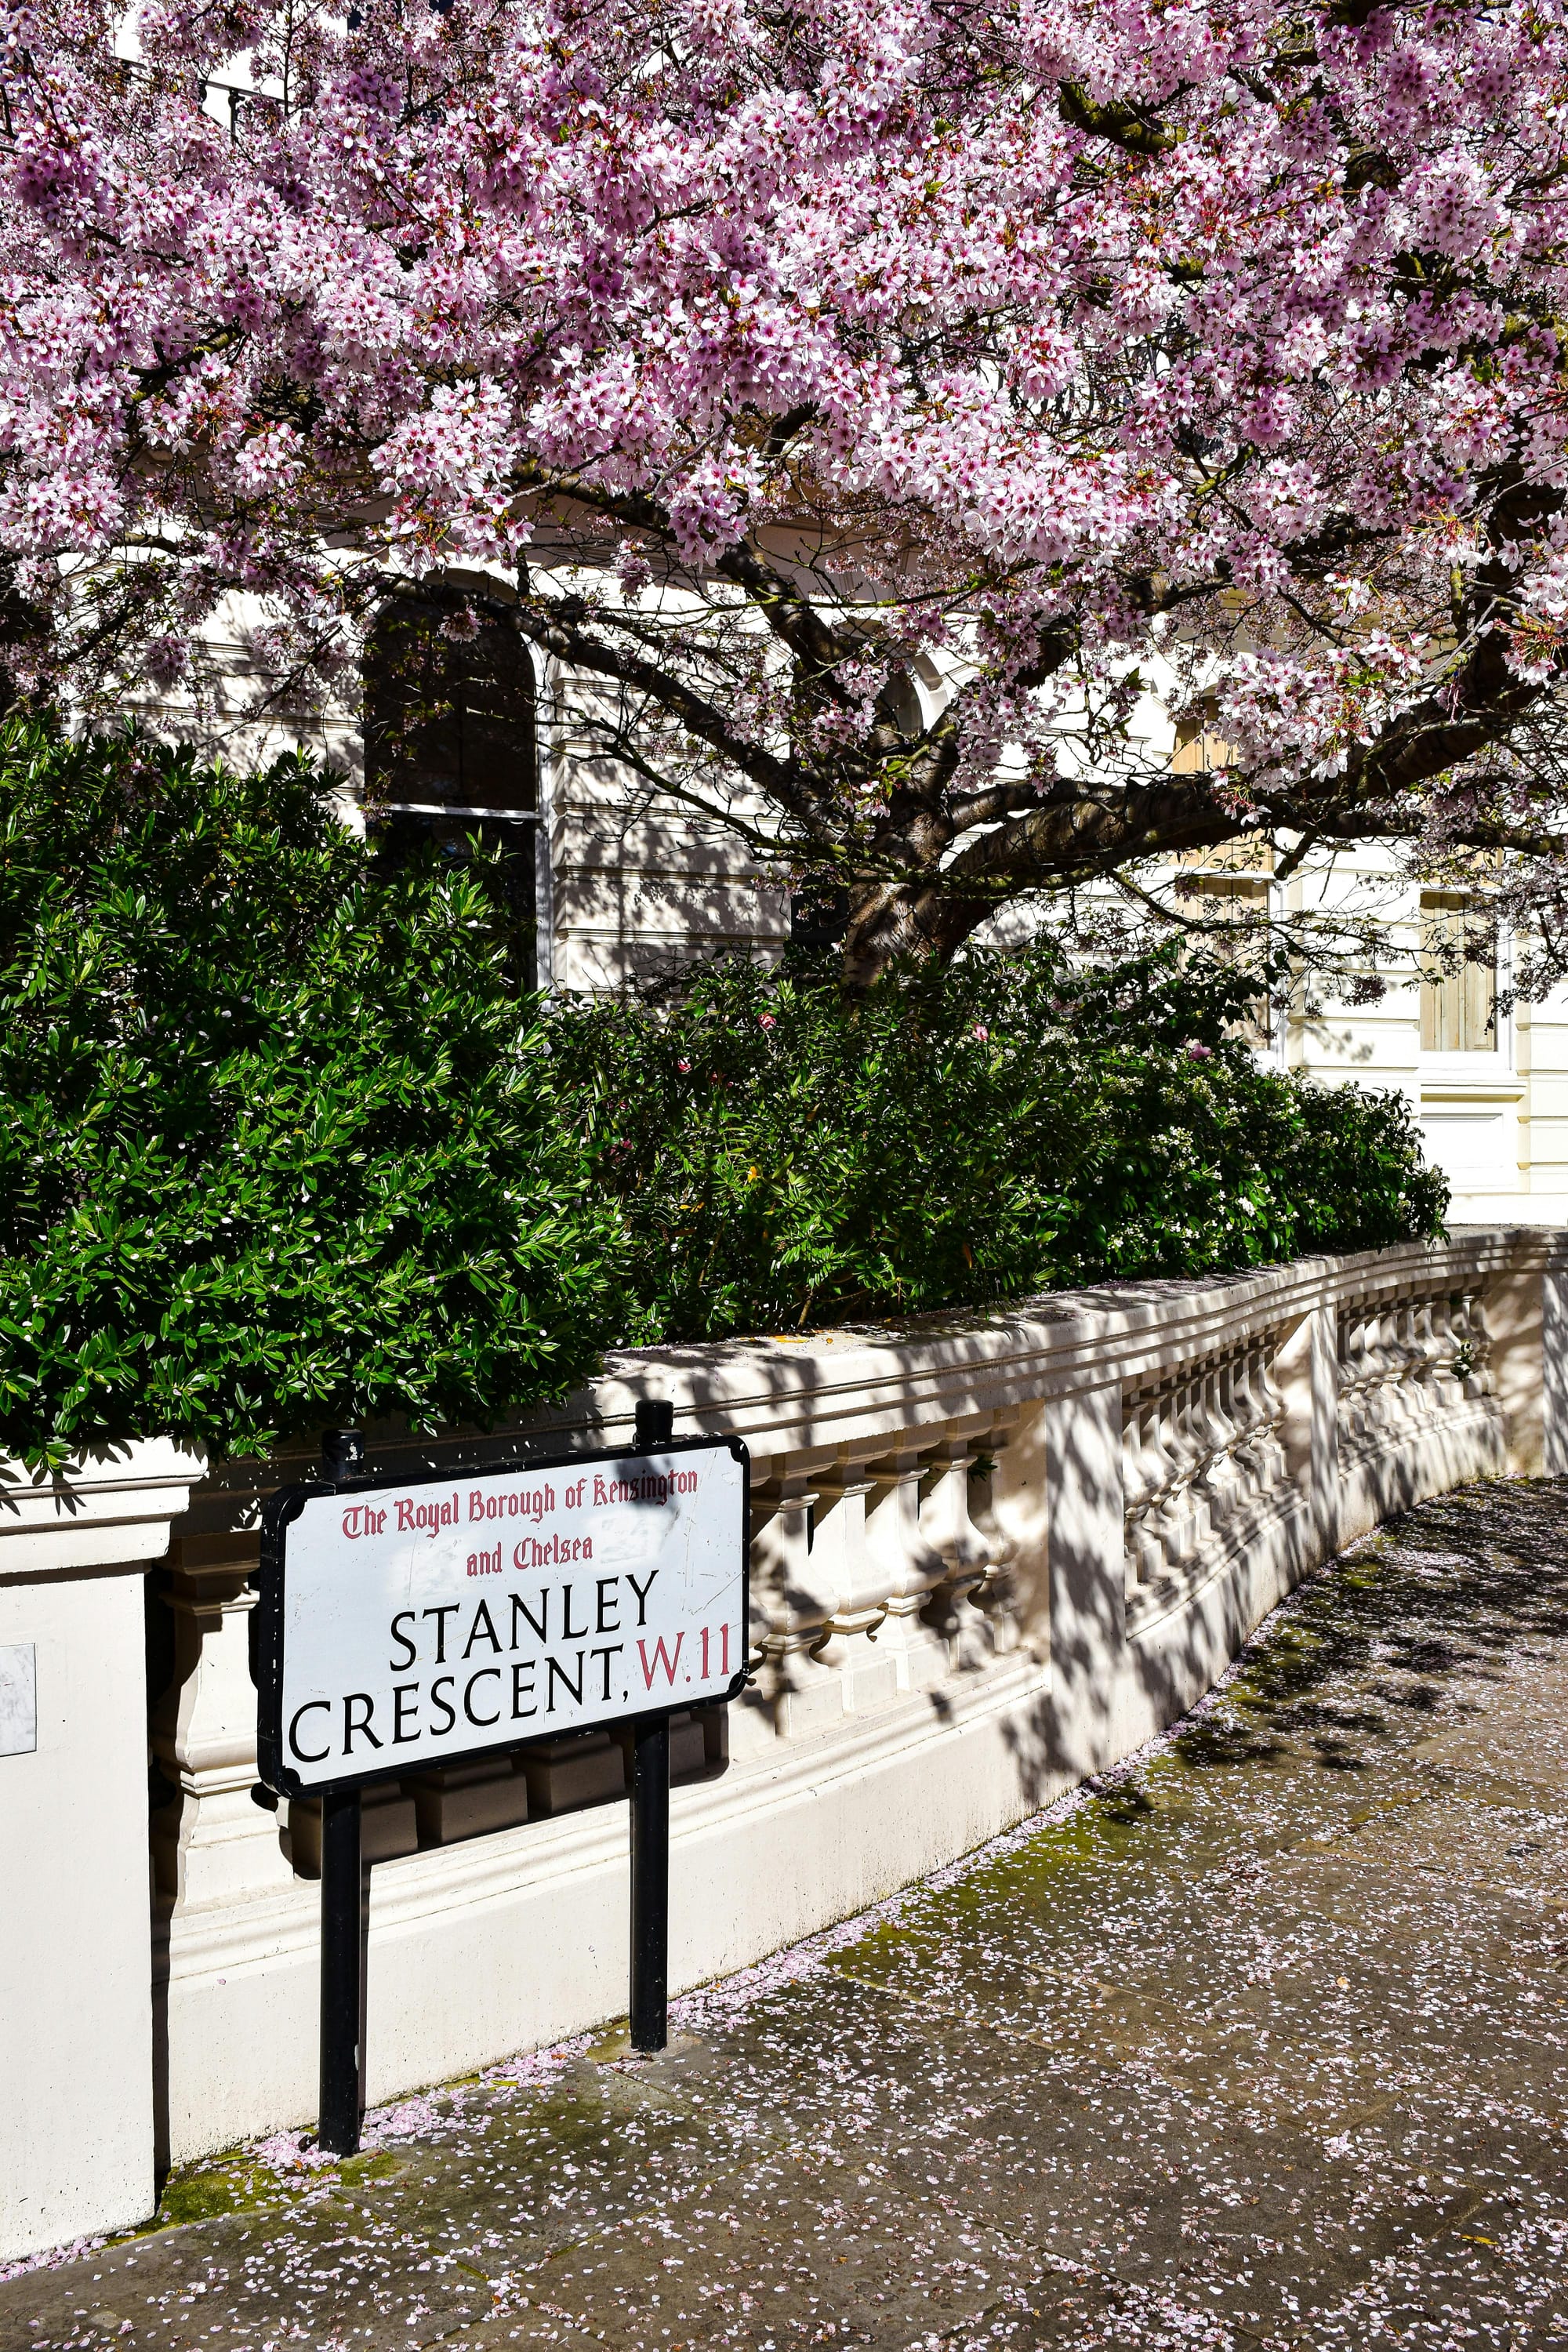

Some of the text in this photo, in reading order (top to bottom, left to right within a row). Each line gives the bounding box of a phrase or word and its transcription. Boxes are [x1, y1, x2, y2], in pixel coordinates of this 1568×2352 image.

[342, 1470, 698, 1540] The Royal Borough of Kensington
[466, 1534, 593, 1577] and Chelsea
[389, 1570, 659, 1671] STANLEY
[289, 1623, 729, 1762] CRESCENT, W.11
